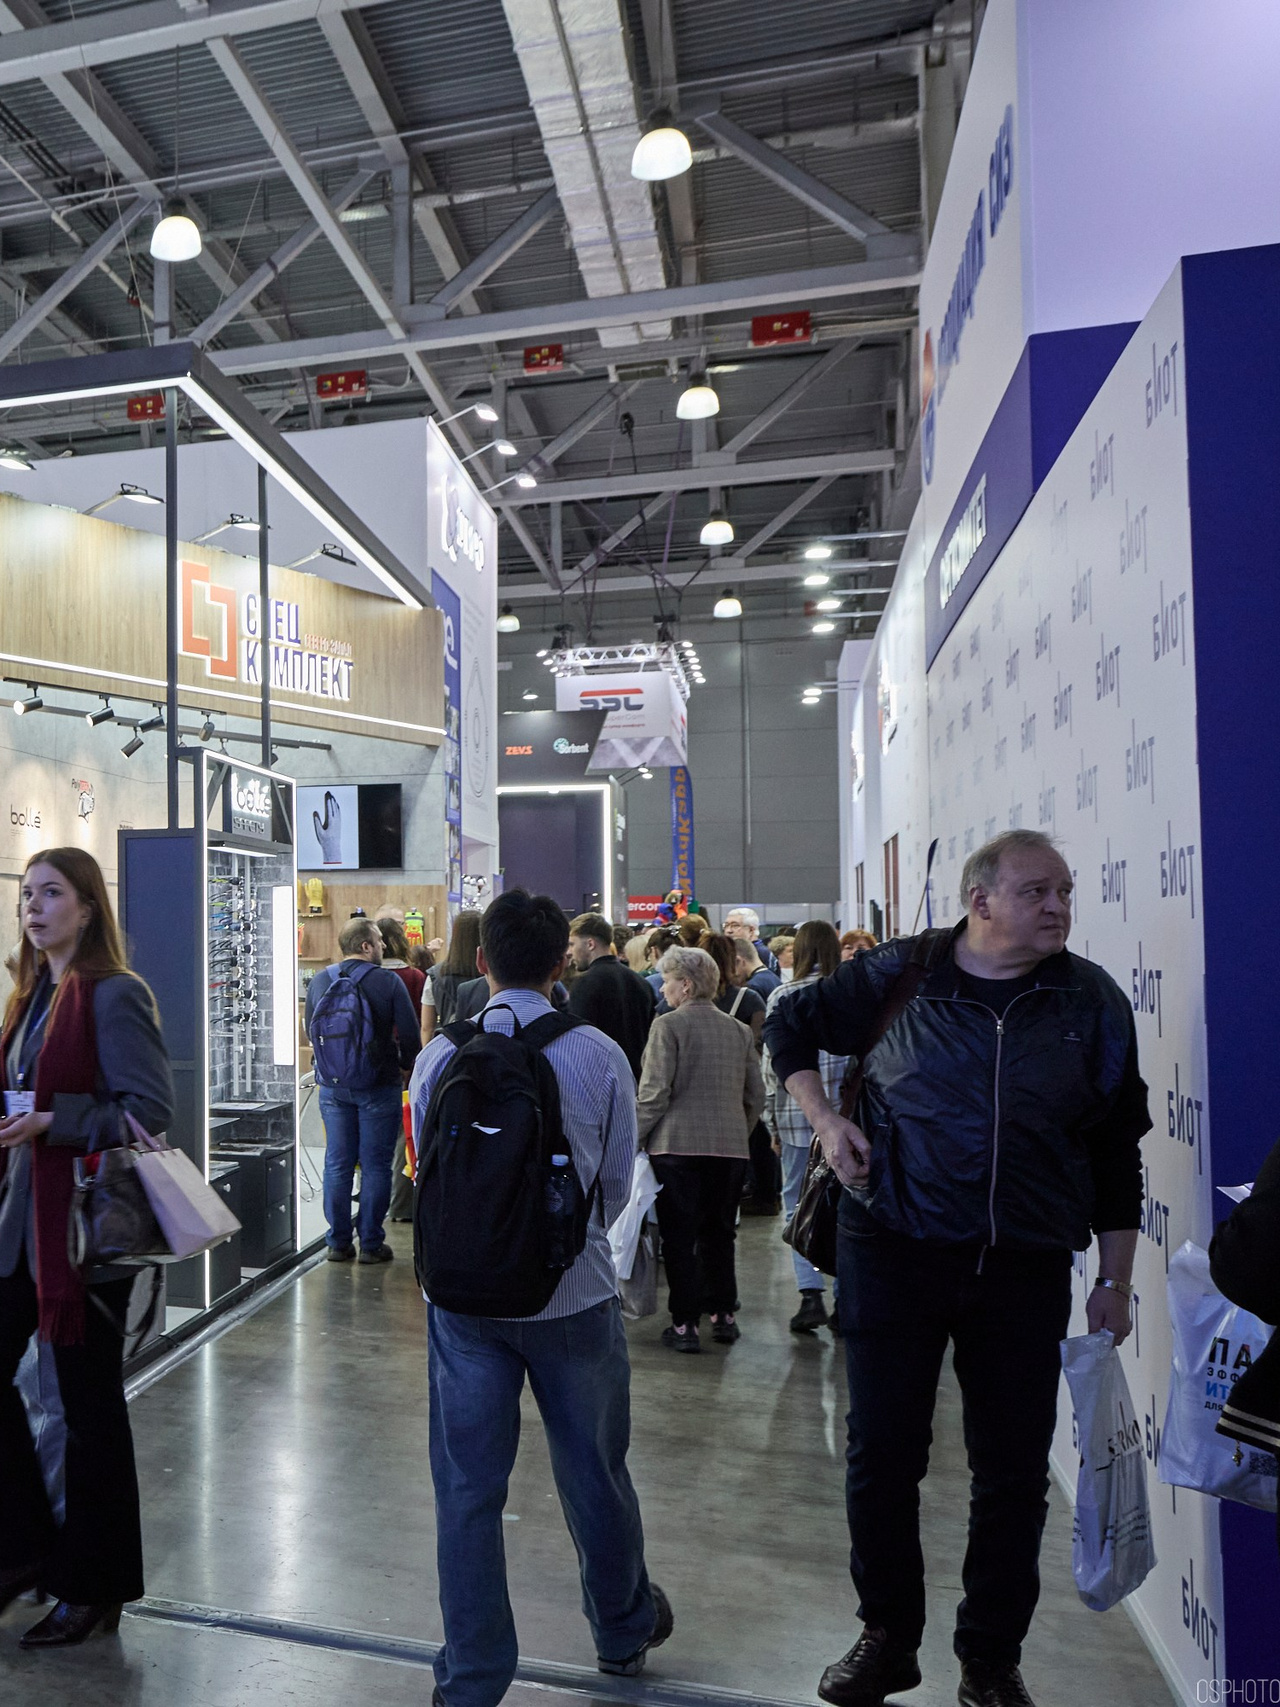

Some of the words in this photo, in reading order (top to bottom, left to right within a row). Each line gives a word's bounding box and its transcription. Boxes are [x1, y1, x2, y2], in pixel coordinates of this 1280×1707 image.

[1145, 341, 1178, 429] БИОТ
[1090, 429, 1115, 501] БИОТ
[1120, 498, 1148, 575] БИОТ
[245, 592, 301, 645] СЕЦ
[1153, 580, 1187, 666] БИОТ
[246, 639, 355, 700] КМПЛЕКТ
[1096, 632, 1121, 708] БИОТ
[505, 745, 533, 756] ZEVS
[1077, 748, 1098, 823] БИОТ
[1126, 718, 1155, 804] БИОТ
[10, 804, 42, 829] bollé
[1102, 837, 1127, 922] БИОТ
[1160, 820, 1195, 919] БИОТ
[1132, 941, 1162, 1038] БИОТ
[1167, 1063, 1203, 1176] БИОТ
[1204, 1401, 1223, 1412] ДЛЯ
[1182, 1558, 1218, 1700] БИОТ
